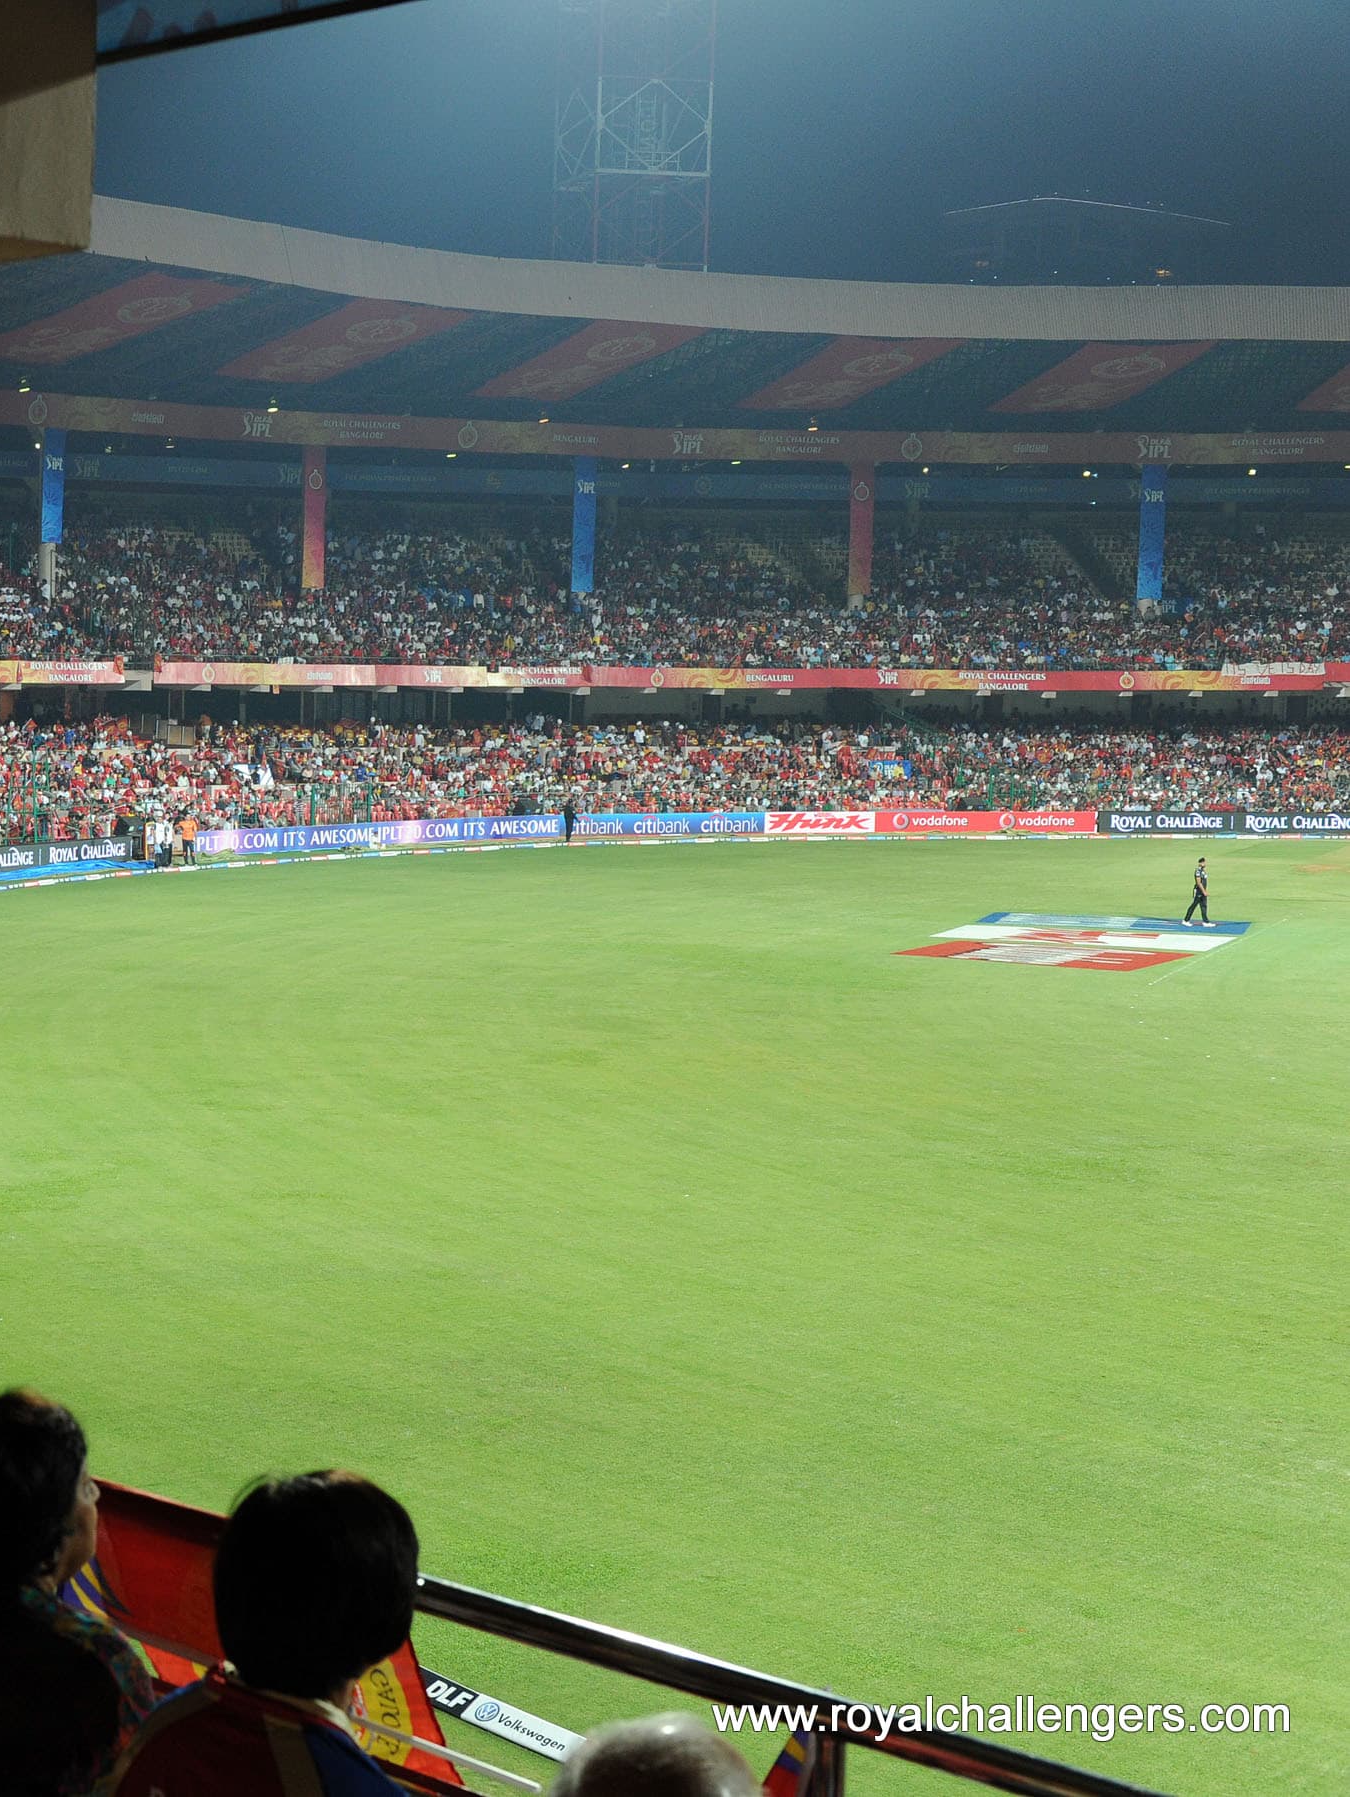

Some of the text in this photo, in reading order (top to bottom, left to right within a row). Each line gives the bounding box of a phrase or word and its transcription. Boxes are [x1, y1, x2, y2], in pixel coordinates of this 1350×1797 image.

[1149, 446, 1172, 458] IPL
[30, 662, 107, 672] ROYAL CHALLENGERS
[48, 674, 93, 682] BANGALORE
[746, 674, 794, 683] BENGALURU
[885, 676, 898, 684] IPL
[959, 672, 1046, 681] ROYAL CHALLENGERS
[978, 683, 1029, 692] BANGALORE
[463, 823, 485, 836] IT'S
[491, 818, 559, 836] AWESOME
[634, 816, 690, 834] citibank
[701, 815, 758, 832] citibank
[769, 812, 870, 833] Hunk
[912, 816, 969, 826] vodafone
[1018, 815, 1075, 826] vodafone
[1111, 812, 1222, 832] ROYAL CHALLENGE
[1246, 814, 1287, 832] ROYAL
[197, 827, 373, 852] PLT0.COM IT'S AWESOME
[49, 839, 126, 871] ROYAL CHALLENGE
[426, 1680, 474, 1709] DLF
[497, 1713, 566, 1752] Volkswagen
